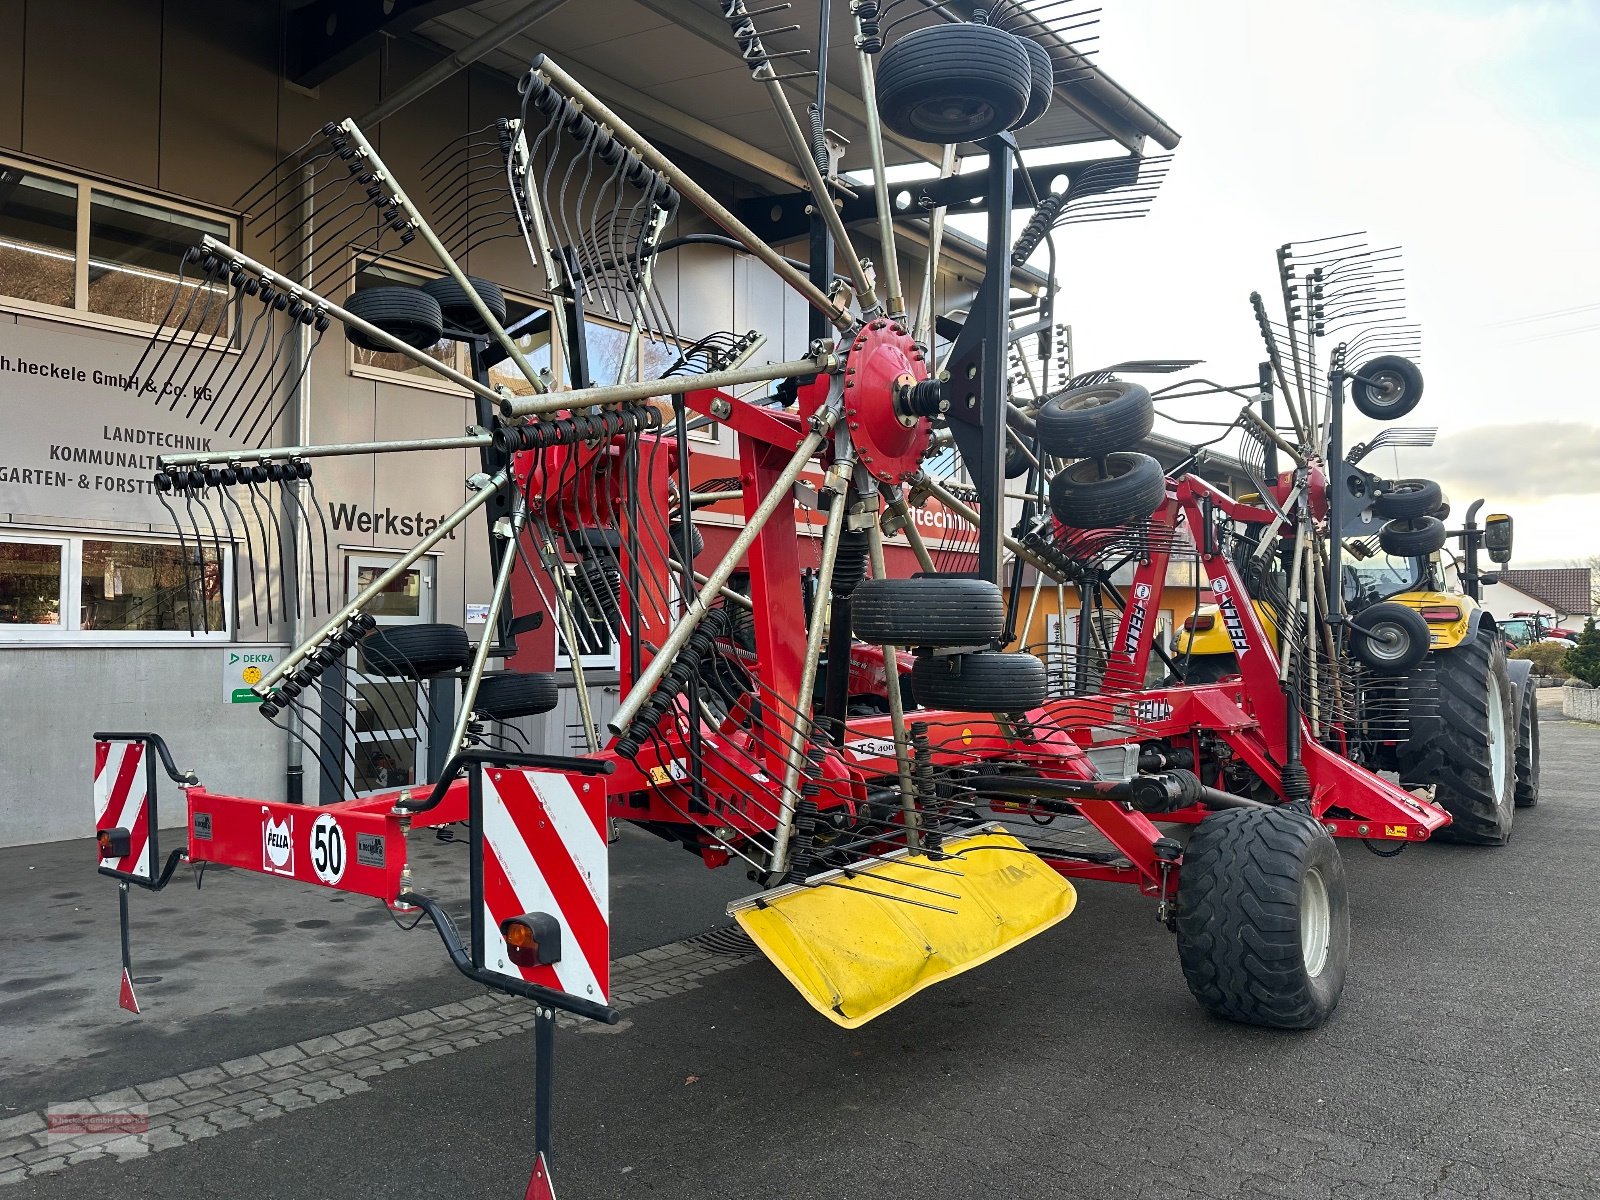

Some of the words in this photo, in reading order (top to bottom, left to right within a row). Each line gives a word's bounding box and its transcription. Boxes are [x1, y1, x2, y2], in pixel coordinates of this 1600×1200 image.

[0, 355, 86, 382] h.heckele
[92, 370, 139, 390] GmbH
[145, 378, 158, 393] &
[163, 381, 187, 398] Co.
[193, 385, 213, 401] KG
[103, 425, 212, 452] LANDTECHNIK
[77, 474, 90, 489] &
[1123, 603, 1147, 654] FELLA
[1219, 596, 1251, 650] FELLA
[243, 654, 274, 663] DEKRA
[1136, 699, 1172, 725] FELLA
[858, 742, 875, 755] TS
[315, 824, 342, 876] 50
